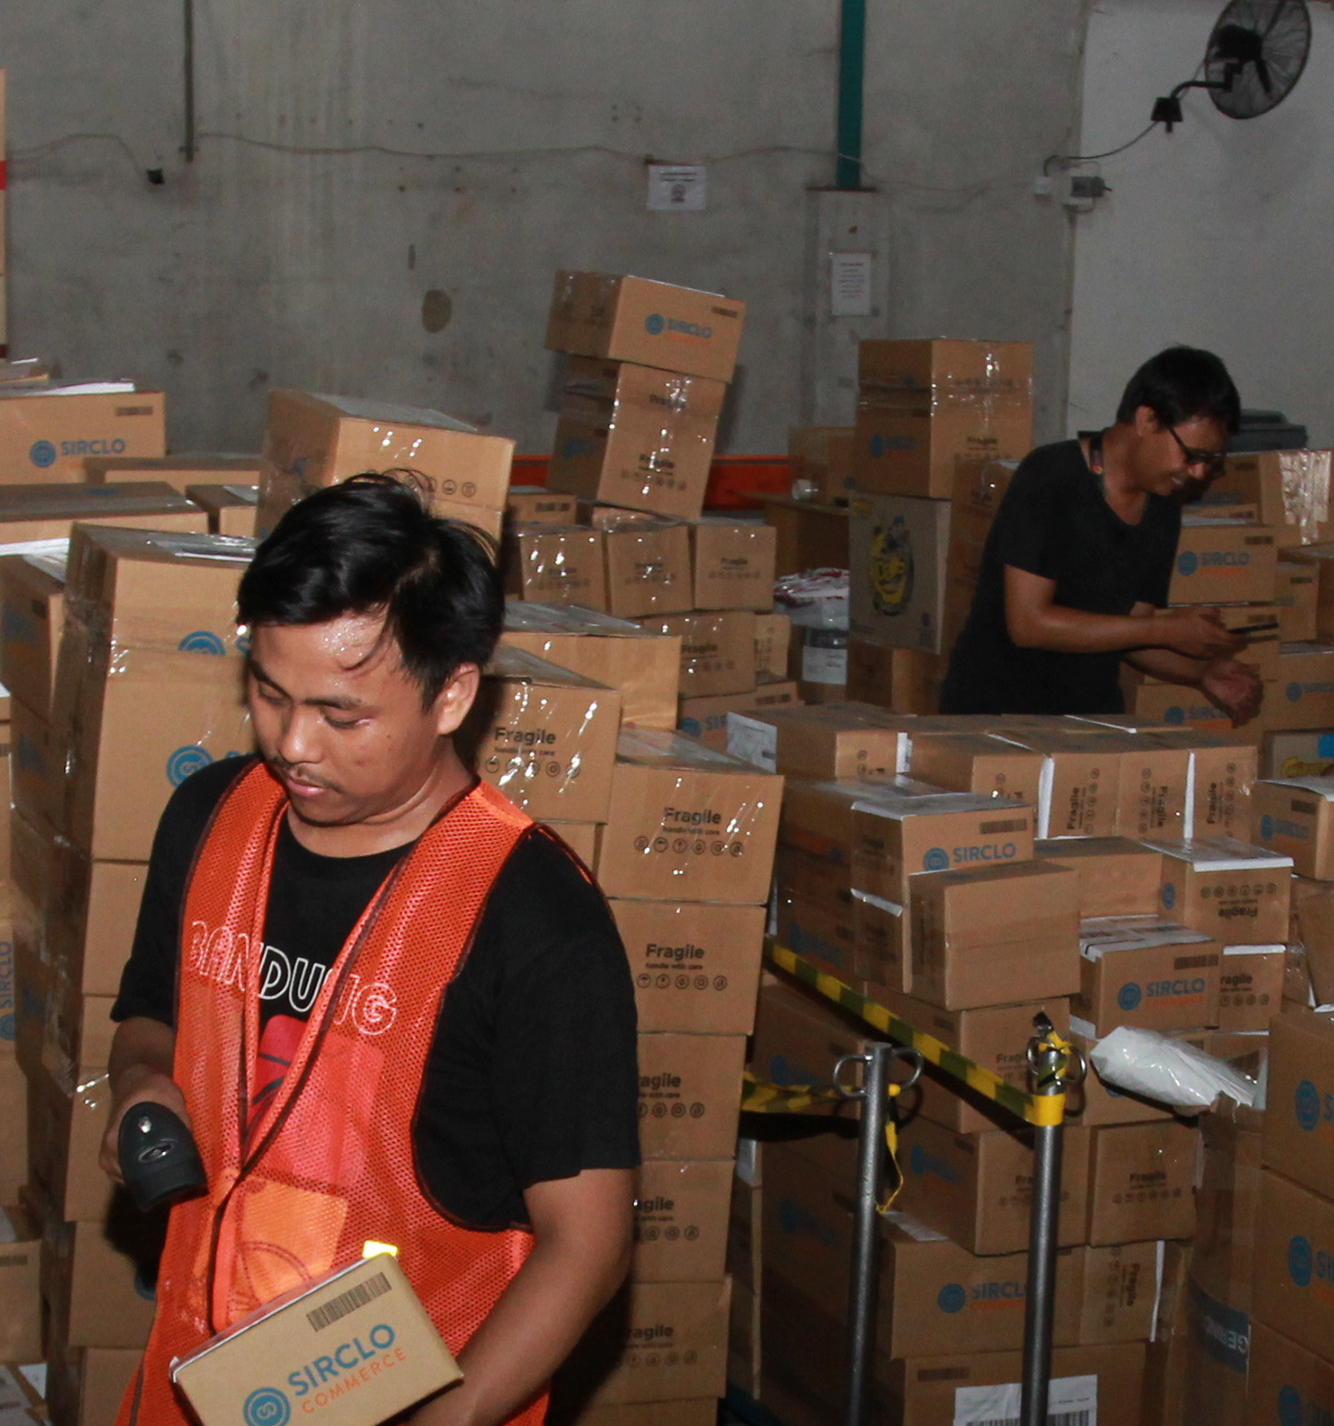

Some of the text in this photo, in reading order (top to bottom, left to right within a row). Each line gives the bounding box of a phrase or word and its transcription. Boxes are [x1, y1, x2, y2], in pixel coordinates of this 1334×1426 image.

[664, 316, 713, 339] SIRCLO
[61, 438, 126, 457] SIRCLO
[1200, 551, 1250, 566] SIRCLO
[494, 727, 556, 747] Fragile
[664, 807, 722, 826] Fragile
[1065, 785, 1080, 832] Fragile
[1067, 786, 1079, 832] Fragile
[953, 842, 1017, 864] SIRCLO
[645, 943, 705, 963] Fragile
[1146, 977, 1208, 998] SIRCLO
[1130, 1170, 1167, 1182] Fragile
[288, 1323, 396, 1397] SIRCLO
[300, 1347, 409, 1416] COMMERCE
